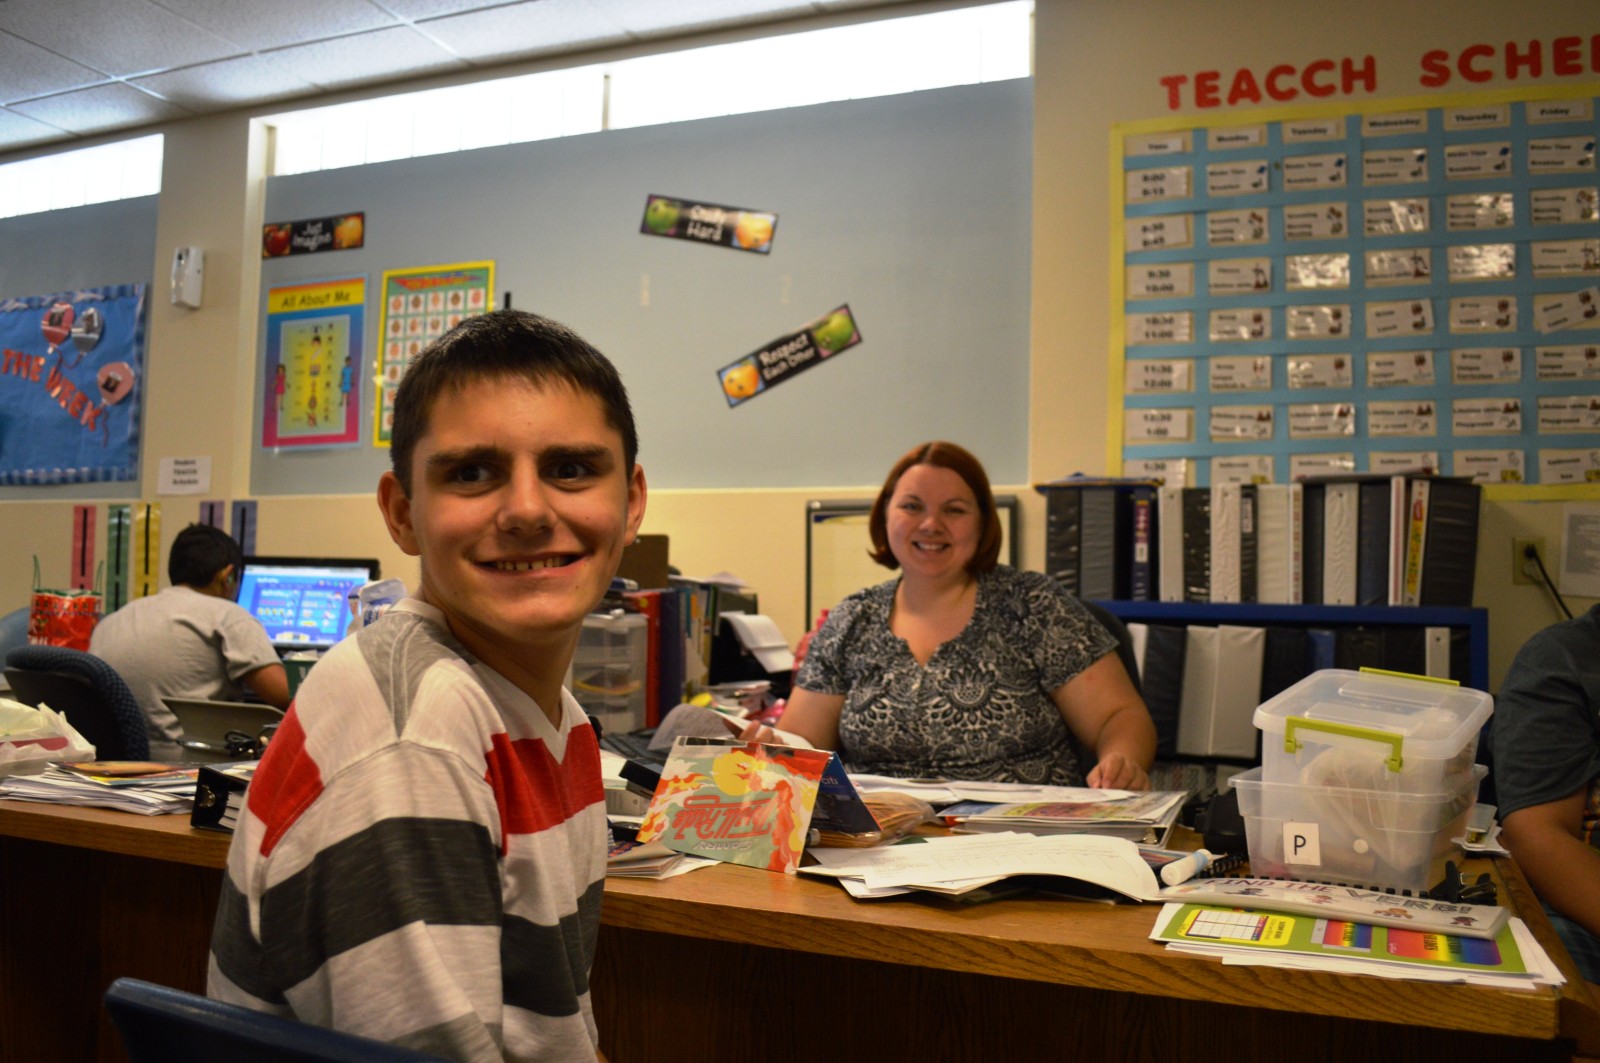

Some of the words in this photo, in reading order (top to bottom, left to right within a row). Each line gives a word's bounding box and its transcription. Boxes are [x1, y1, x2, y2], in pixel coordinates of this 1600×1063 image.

[1159, 55, 1378, 110] TEACCH
[282, 295, 296, 308] All
[300, 292, 331, 306] About
[335, 290, 350, 302] Me
[758, 334, 809, 366] Respect
[2, 348, 46, 383] THE
[45, 365, 103, 432] WEEK
[1293, 834, 1307, 856] P
[1204, 878, 1275, 887] FIND
[1284, 882, 1333, 894] THE
[1346, 888, 1471, 913] VERB!
